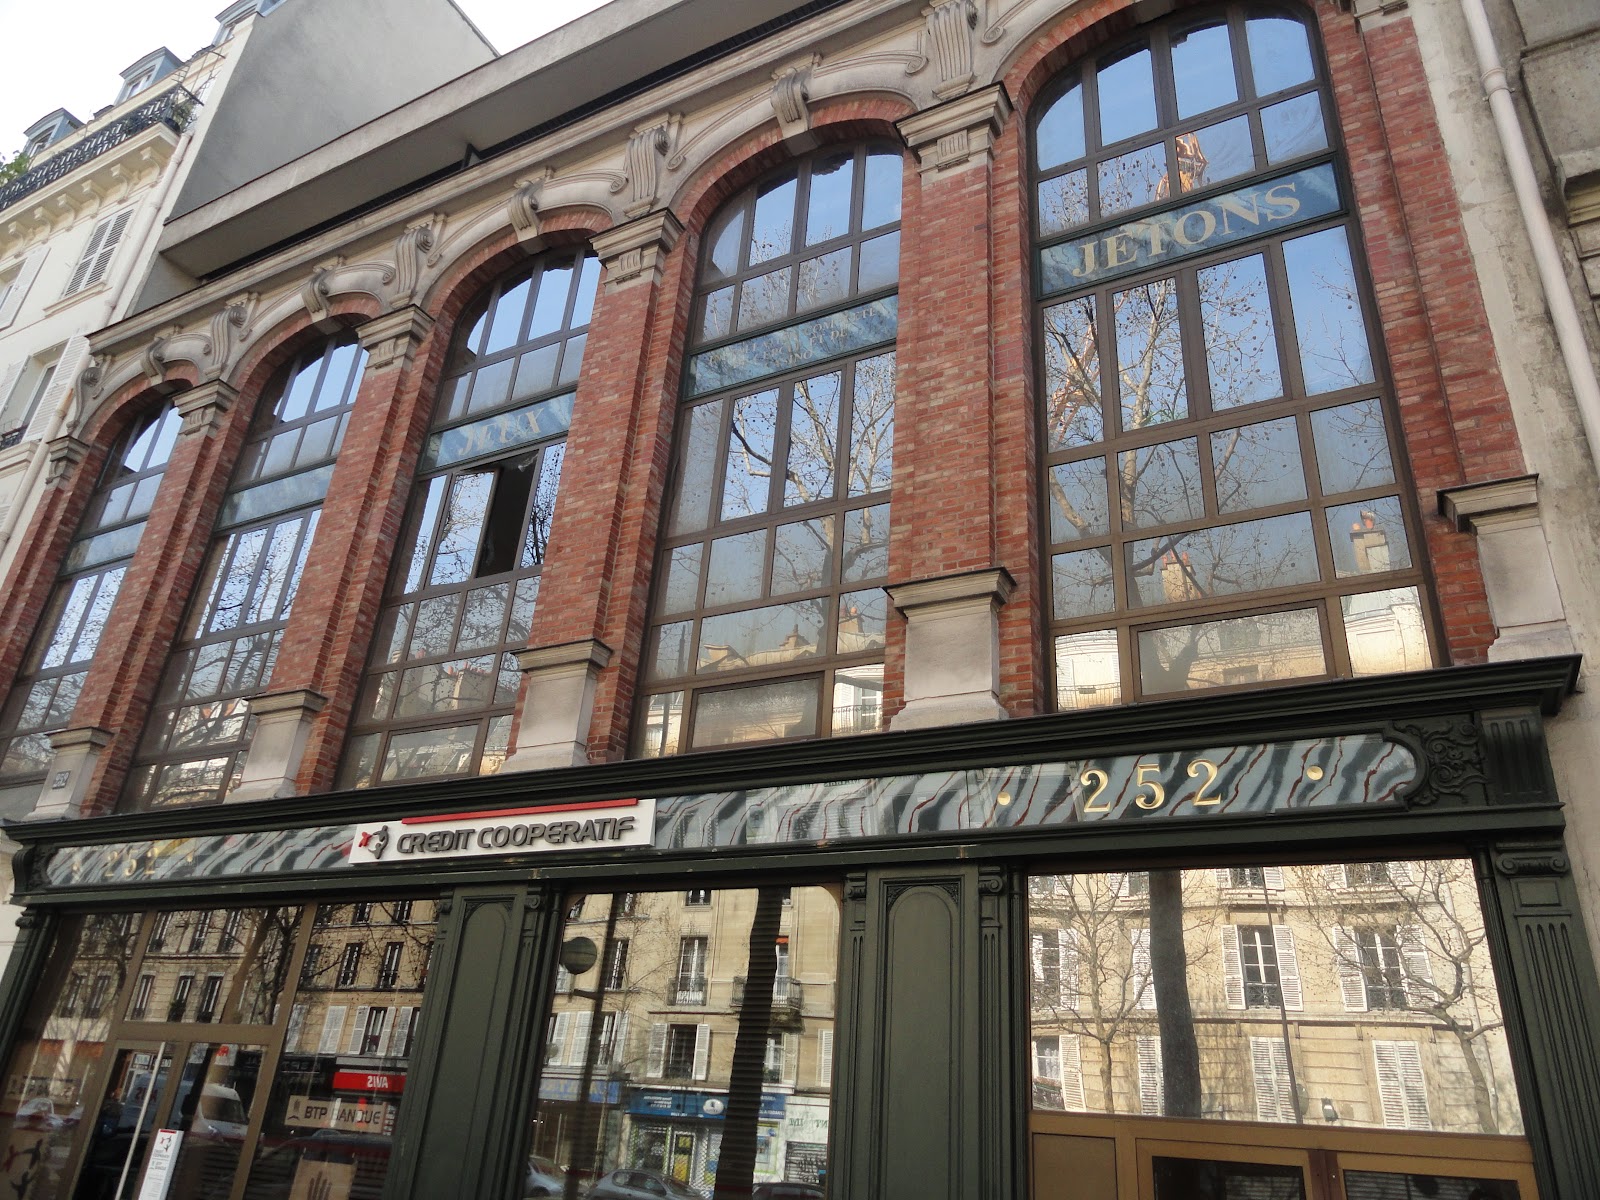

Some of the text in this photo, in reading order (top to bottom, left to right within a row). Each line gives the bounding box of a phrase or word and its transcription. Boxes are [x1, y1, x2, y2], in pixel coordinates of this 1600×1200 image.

[1072, 183, 1301, 278] JETONS
[1080, 758, 1222, 813] 252
[396, 815, 636, 854] CREDIT COOPERATIF
[104, 847, 159, 876] 252
[304, 1105, 329, 1120] BTP
[332, 1107, 381, 1125] ANQUE
